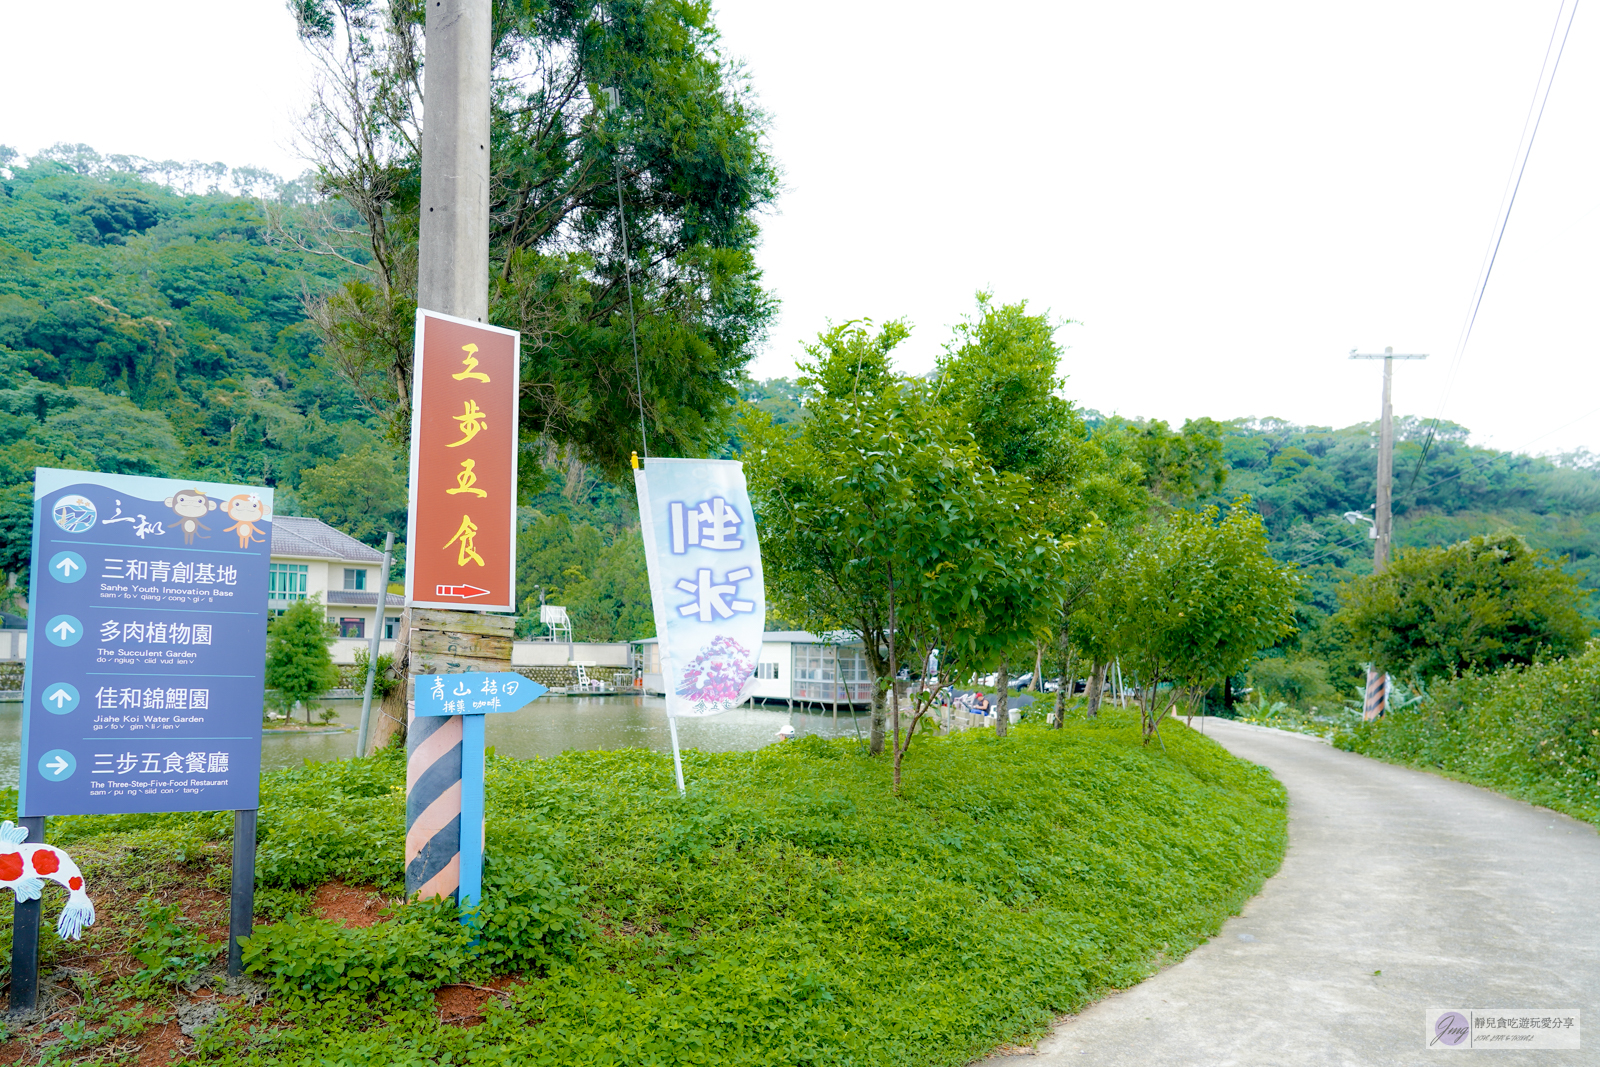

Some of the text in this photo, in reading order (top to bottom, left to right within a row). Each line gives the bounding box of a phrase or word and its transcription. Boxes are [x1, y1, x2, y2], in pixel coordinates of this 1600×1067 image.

[443, 343, 491, 567] 三步五食
[101, 558, 237, 585] 三和青創基地
[100, 583, 234, 597] Sanhe Youth Innovation Base
[100, 619, 212, 645] 多肉植物園
[97, 648, 197, 658] The Succulent Garden
[94, 686, 209, 710] 佳和錦鯉園
[93, 715, 204, 723] Jiahe Koi Water Garden
[91, 751, 229, 775] 三步五食餐廳
[90, 780, 105, 788] The
[107, 779, 188, 788] Three-Step-Five-Food
